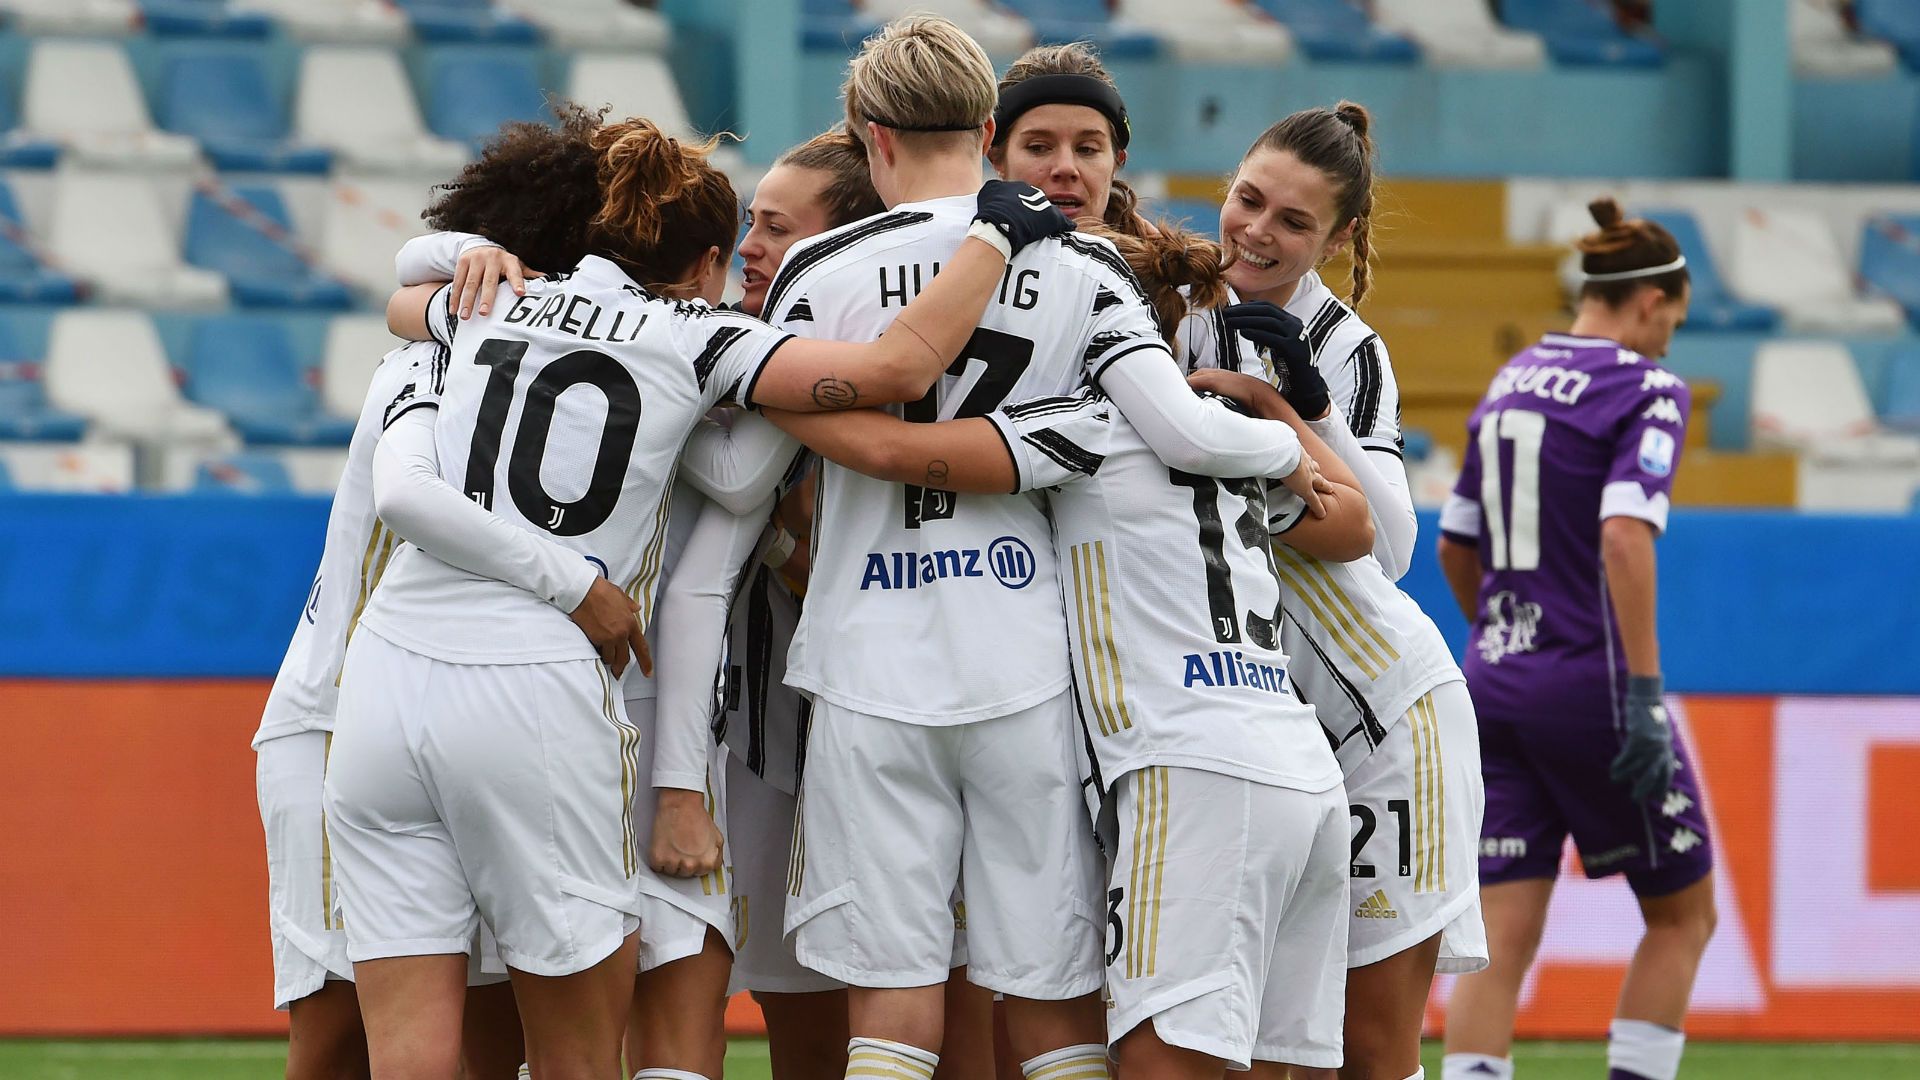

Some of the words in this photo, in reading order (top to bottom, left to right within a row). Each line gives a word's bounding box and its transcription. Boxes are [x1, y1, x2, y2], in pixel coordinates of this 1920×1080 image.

[879, 261, 1040, 310] HUIG
[504, 293, 648, 343] GIRELLI
[463, 338, 642, 537] 10
[860, 549, 983, 591] Allanz
[1183, 651, 1290, 695] Allianz
[1350, 800, 1411, 878] 21
[1355, 908, 1398, 919] adidas
